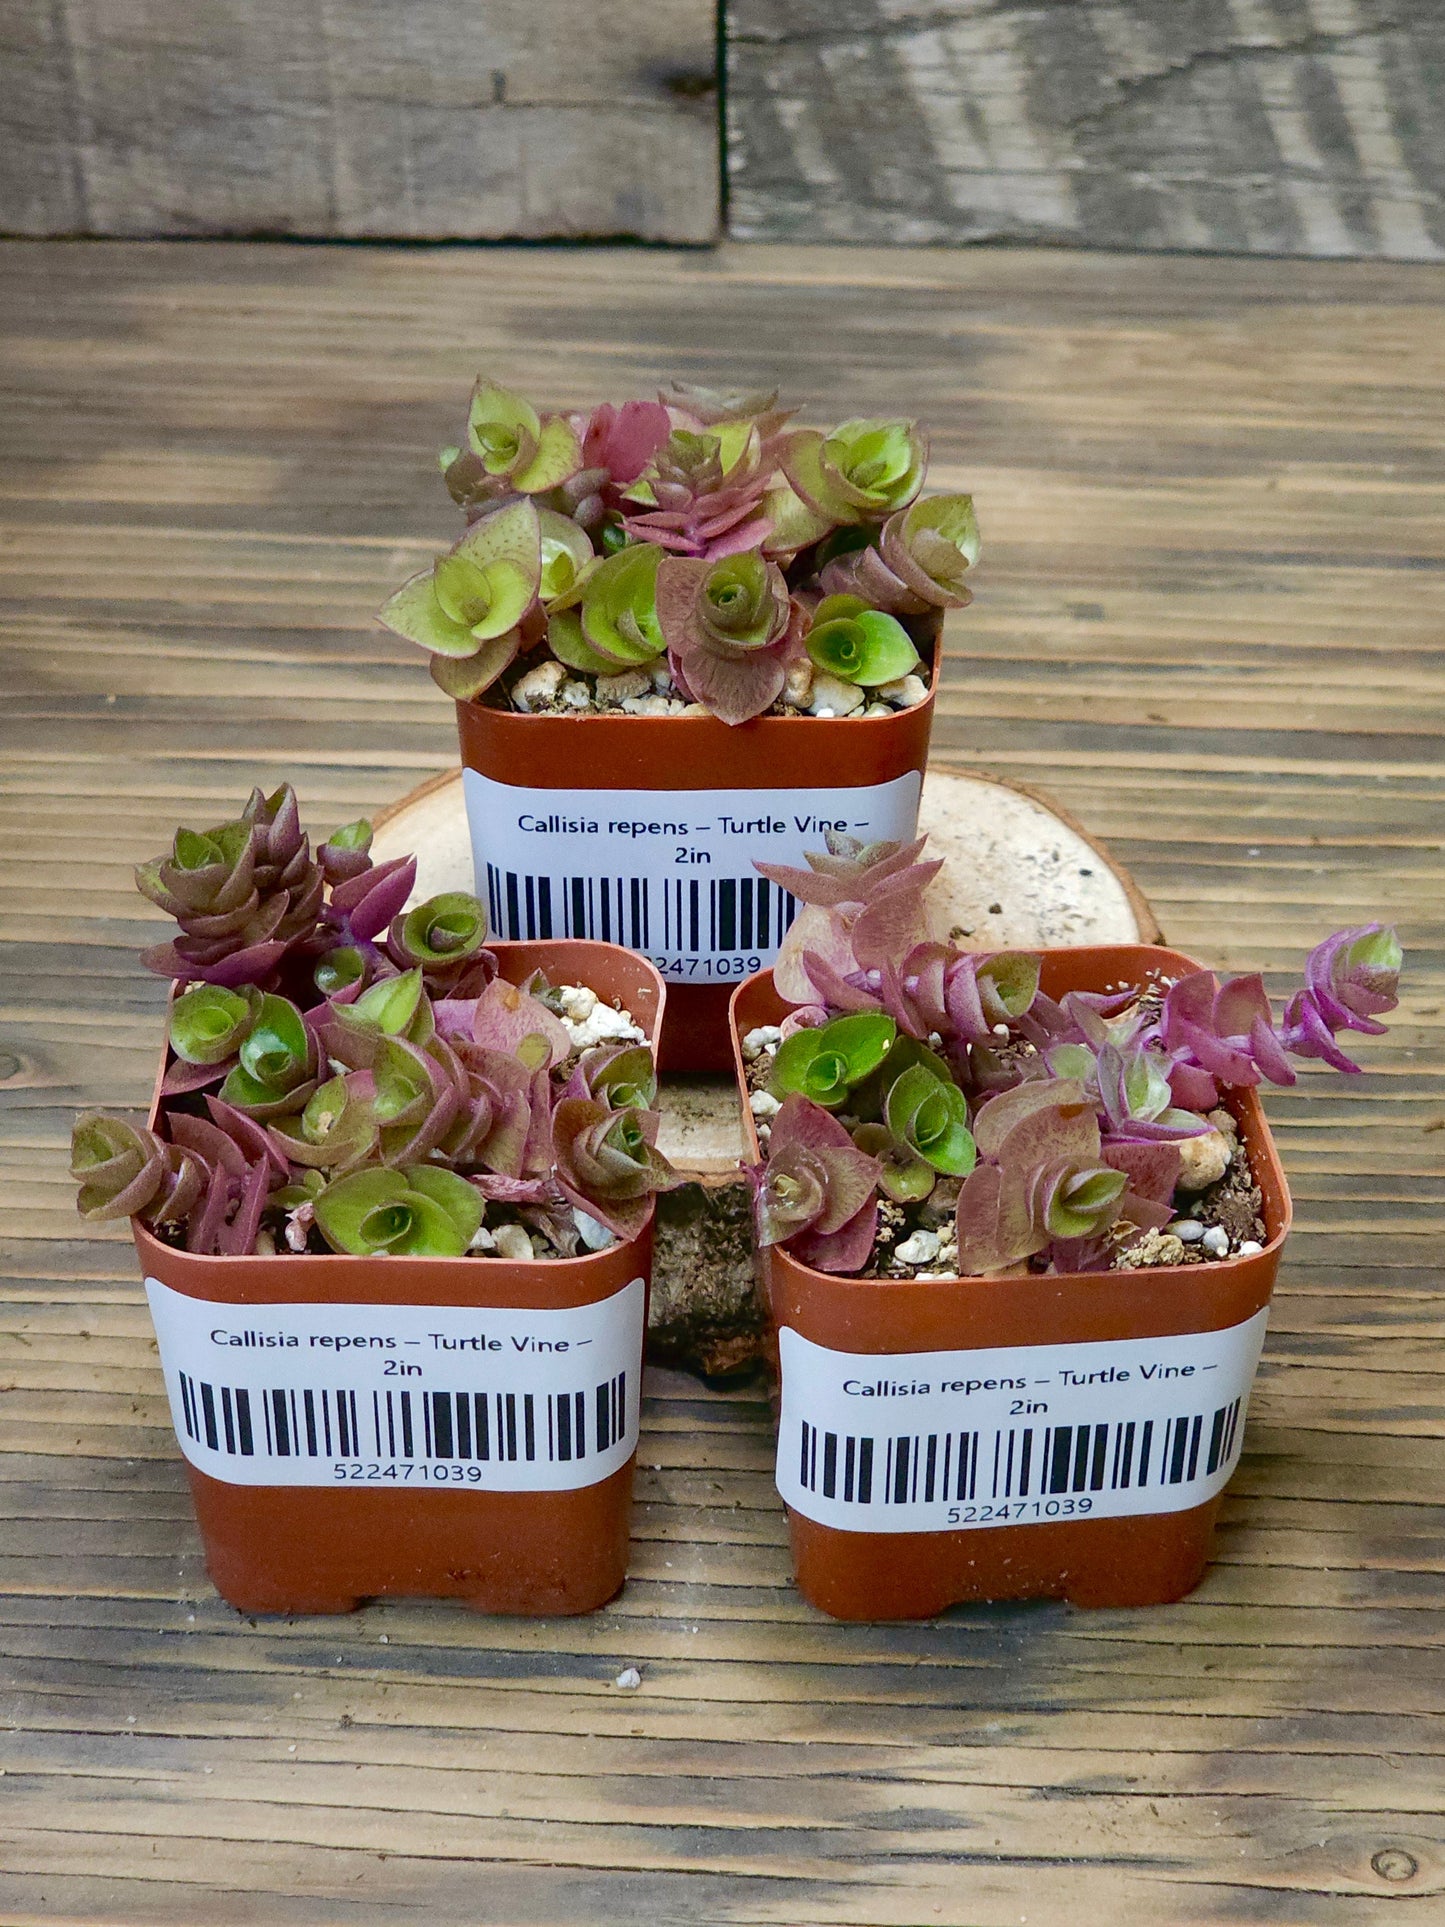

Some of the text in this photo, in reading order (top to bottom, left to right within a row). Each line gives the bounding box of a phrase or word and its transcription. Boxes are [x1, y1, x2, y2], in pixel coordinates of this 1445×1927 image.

[518, 814, 599, 834] Callisia
[608, 821, 689, 837] repens
[717, 815, 787, 835] Turtle
[793, 815, 848, 833] Vine
[674, 847, 711, 864] 2in
[645, 956, 761, 976] 2471039
[210, 1329, 299, 1348] Callisia
[309, 1335, 397, 1352] repens
[427, 1333, 503, 1352] Turtle
[510, 1335, 570, 1353] Vine
[383, 1360, 423, 1377] 2in
[842, 1379, 931, 1397] Callisia
[941, 1376, 1027, 1394] repens
[1058, 1366, 1131, 1387] Turtle
[1139, 1362, 1196, 1380] Vine
[1009, 1399, 1049, 1416] 2in
[333, 1463, 482, 1483] 522471039
[947, 1497, 1093, 1523] 522471039
